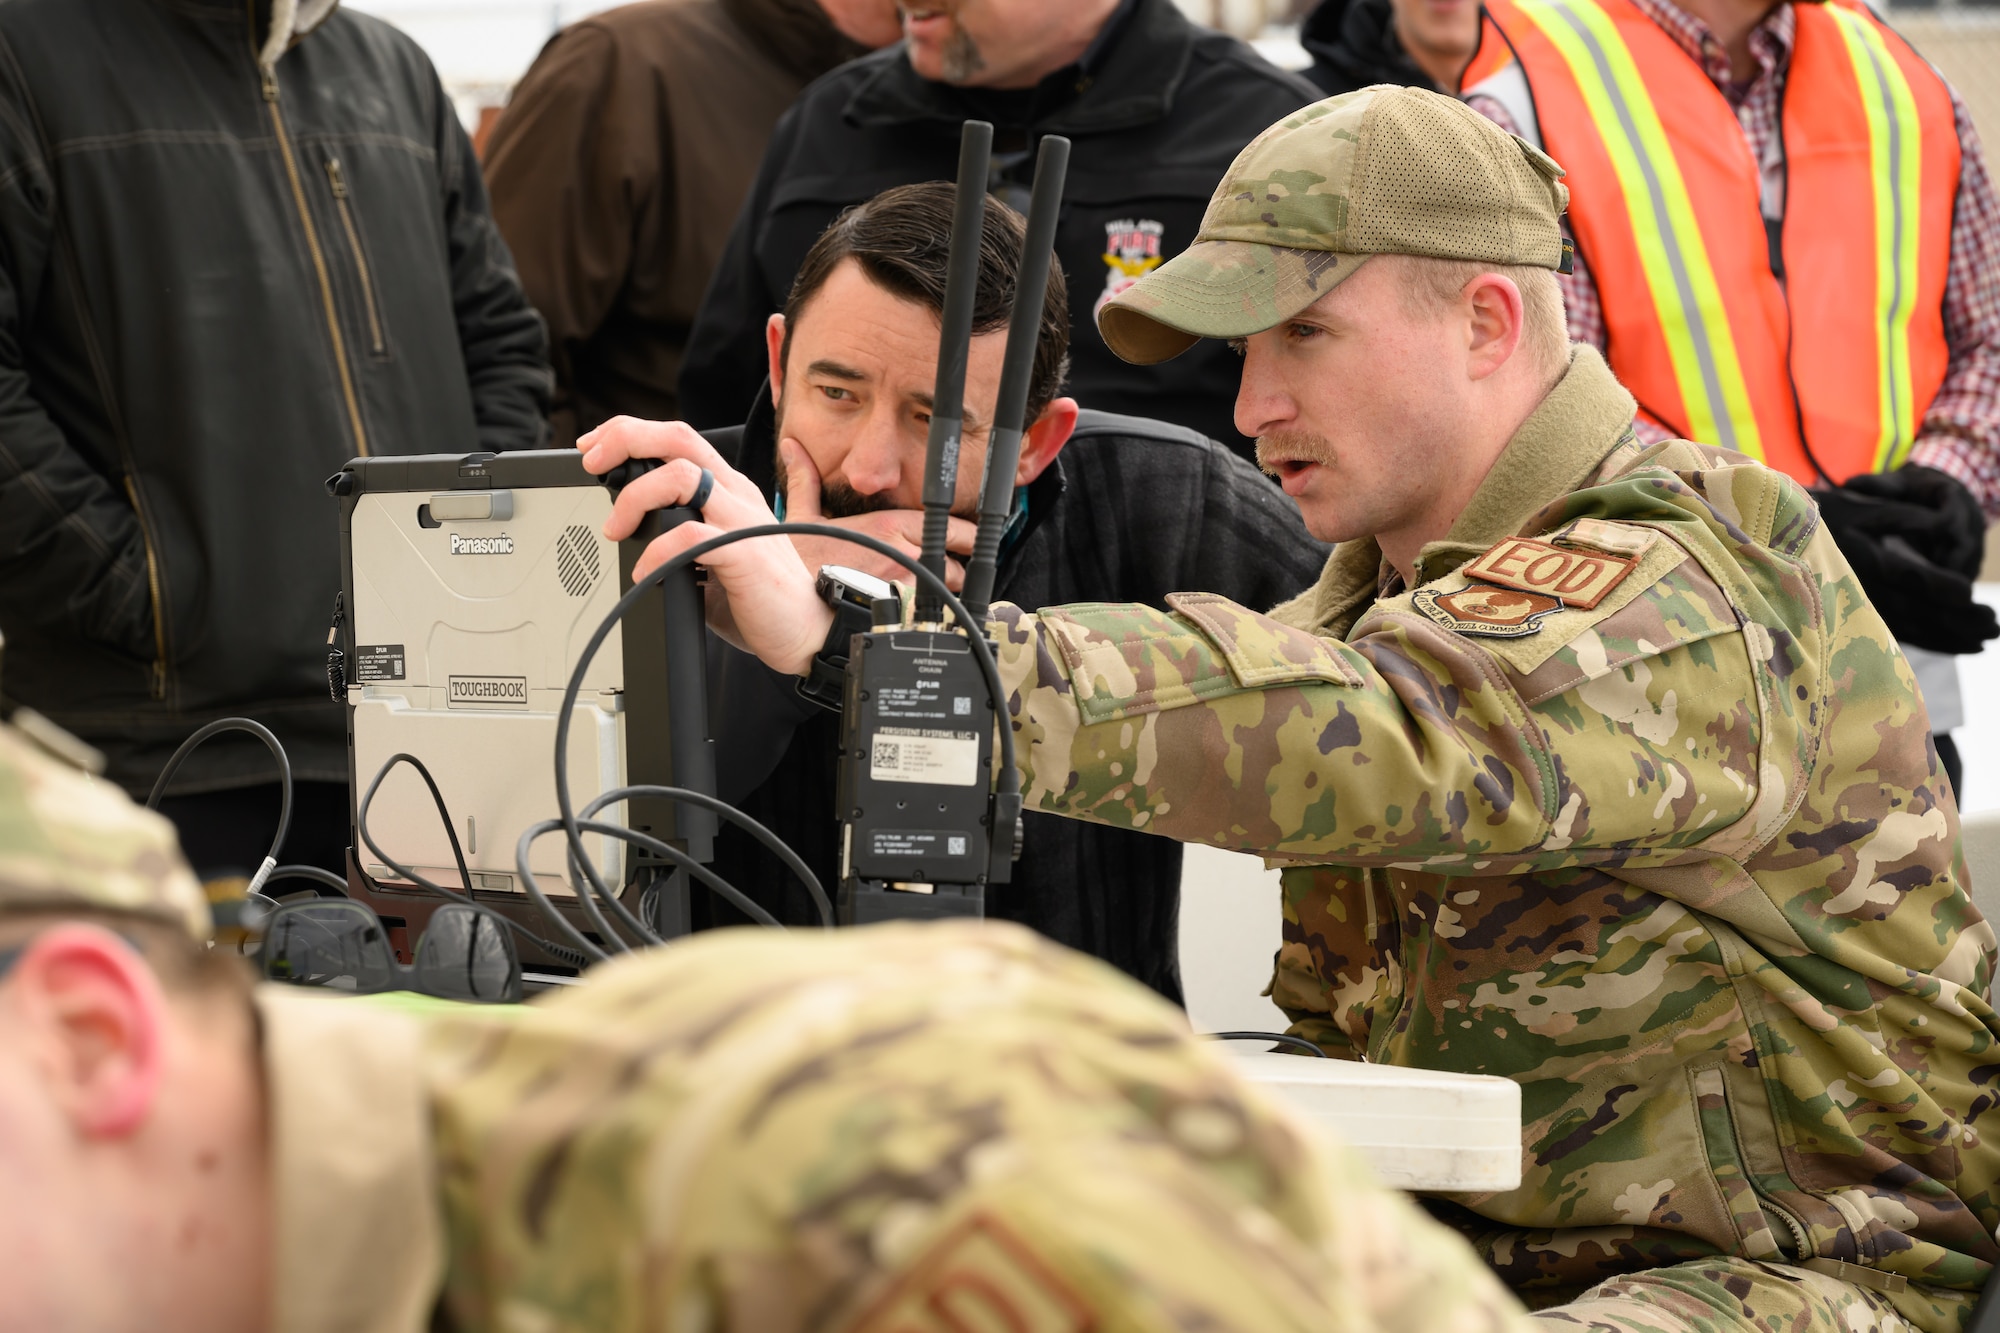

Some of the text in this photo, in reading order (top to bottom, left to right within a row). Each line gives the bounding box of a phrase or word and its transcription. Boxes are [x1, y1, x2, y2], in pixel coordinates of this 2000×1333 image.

[1107, 231, 1160, 256] FIRE
[450, 533, 513, 554] Panasonic
[1486, 542, 1605, 594] EOD
[912, 658, 948, 666] ANTENNA
[918, 666, 943, 674] CHAIN
[452, 682, 524, 697] TOUGHBOOK
[880, 726, 920, 737] PERSISTENT
[957, 731, 971, 740] LLC
